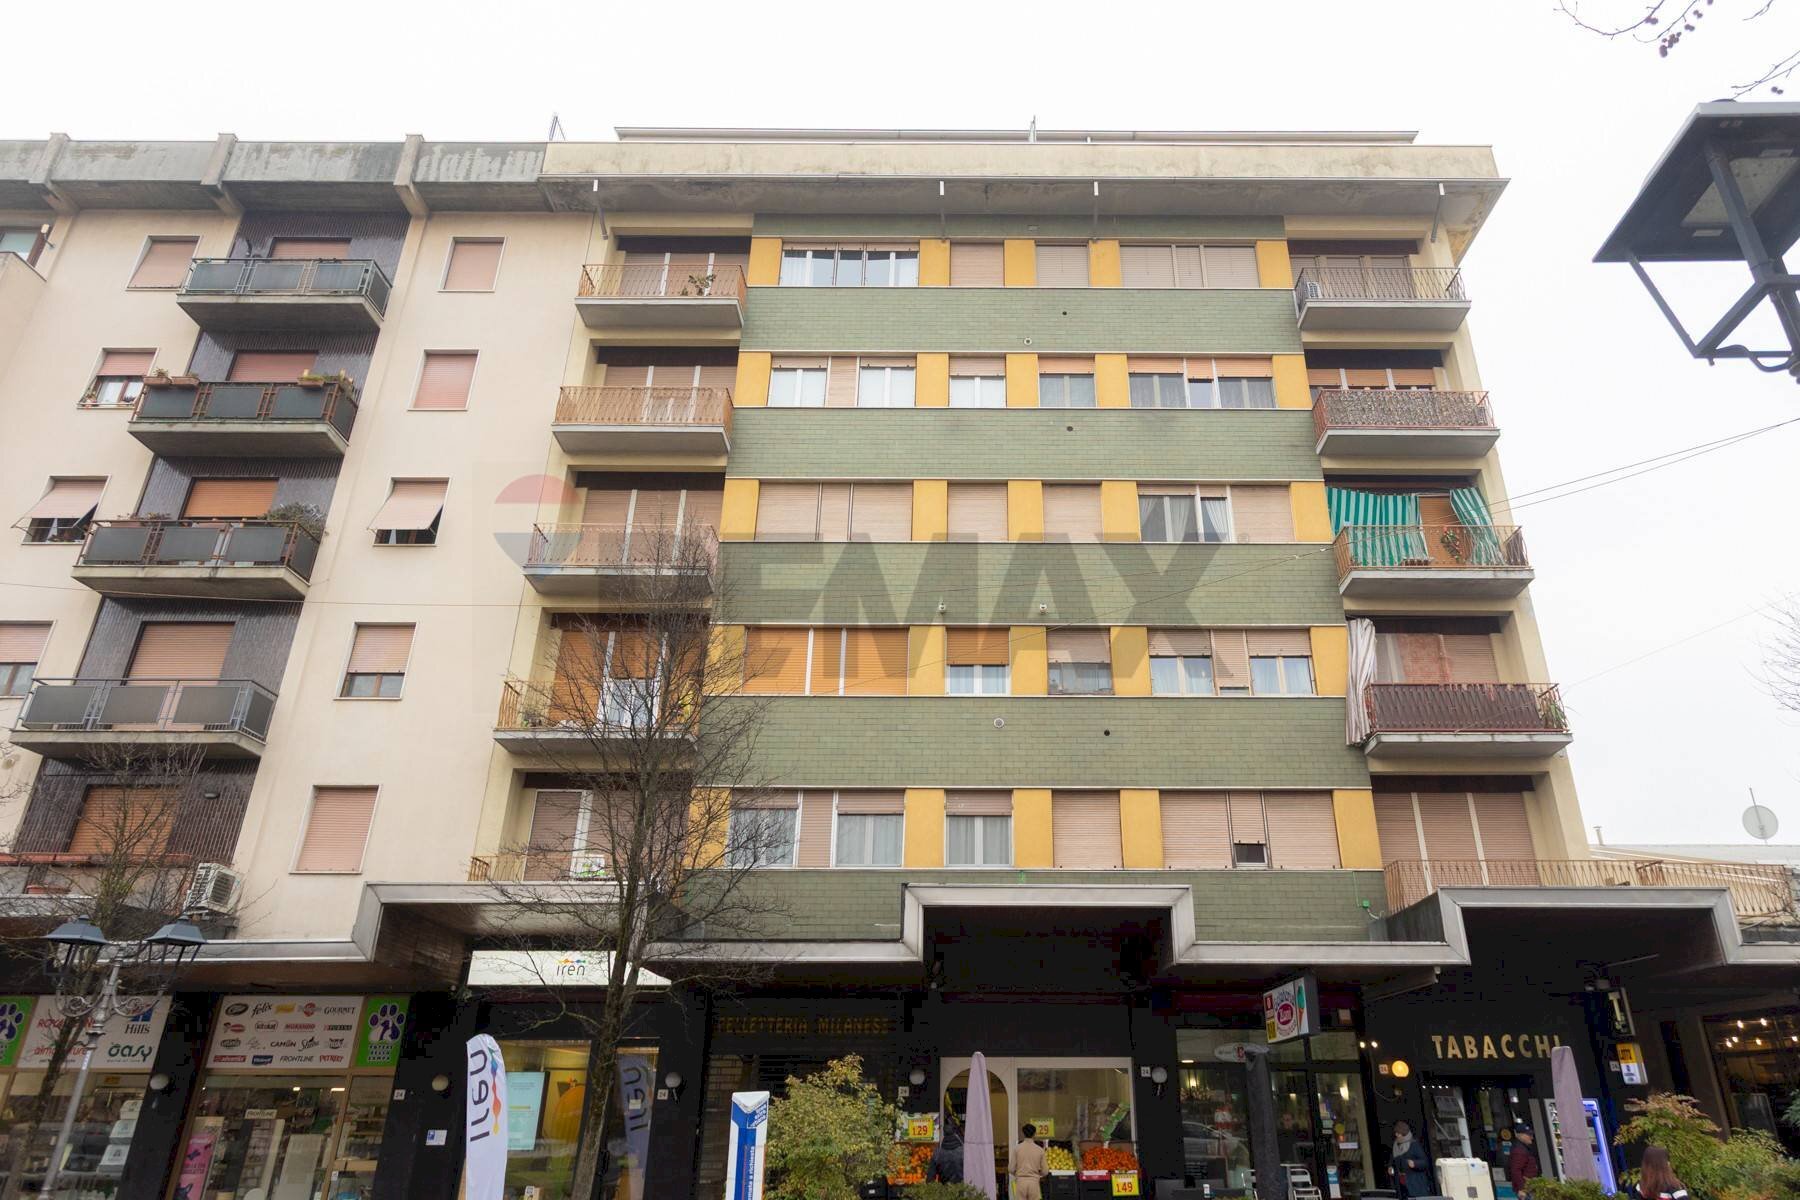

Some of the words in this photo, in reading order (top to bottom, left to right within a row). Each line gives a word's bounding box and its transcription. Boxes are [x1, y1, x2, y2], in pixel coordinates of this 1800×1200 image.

[556, 965, 585, 976] iren
[818, 1017, 889, 1034] MILANESE
[1431, 1034, 1561, 1059] TABACCHI
